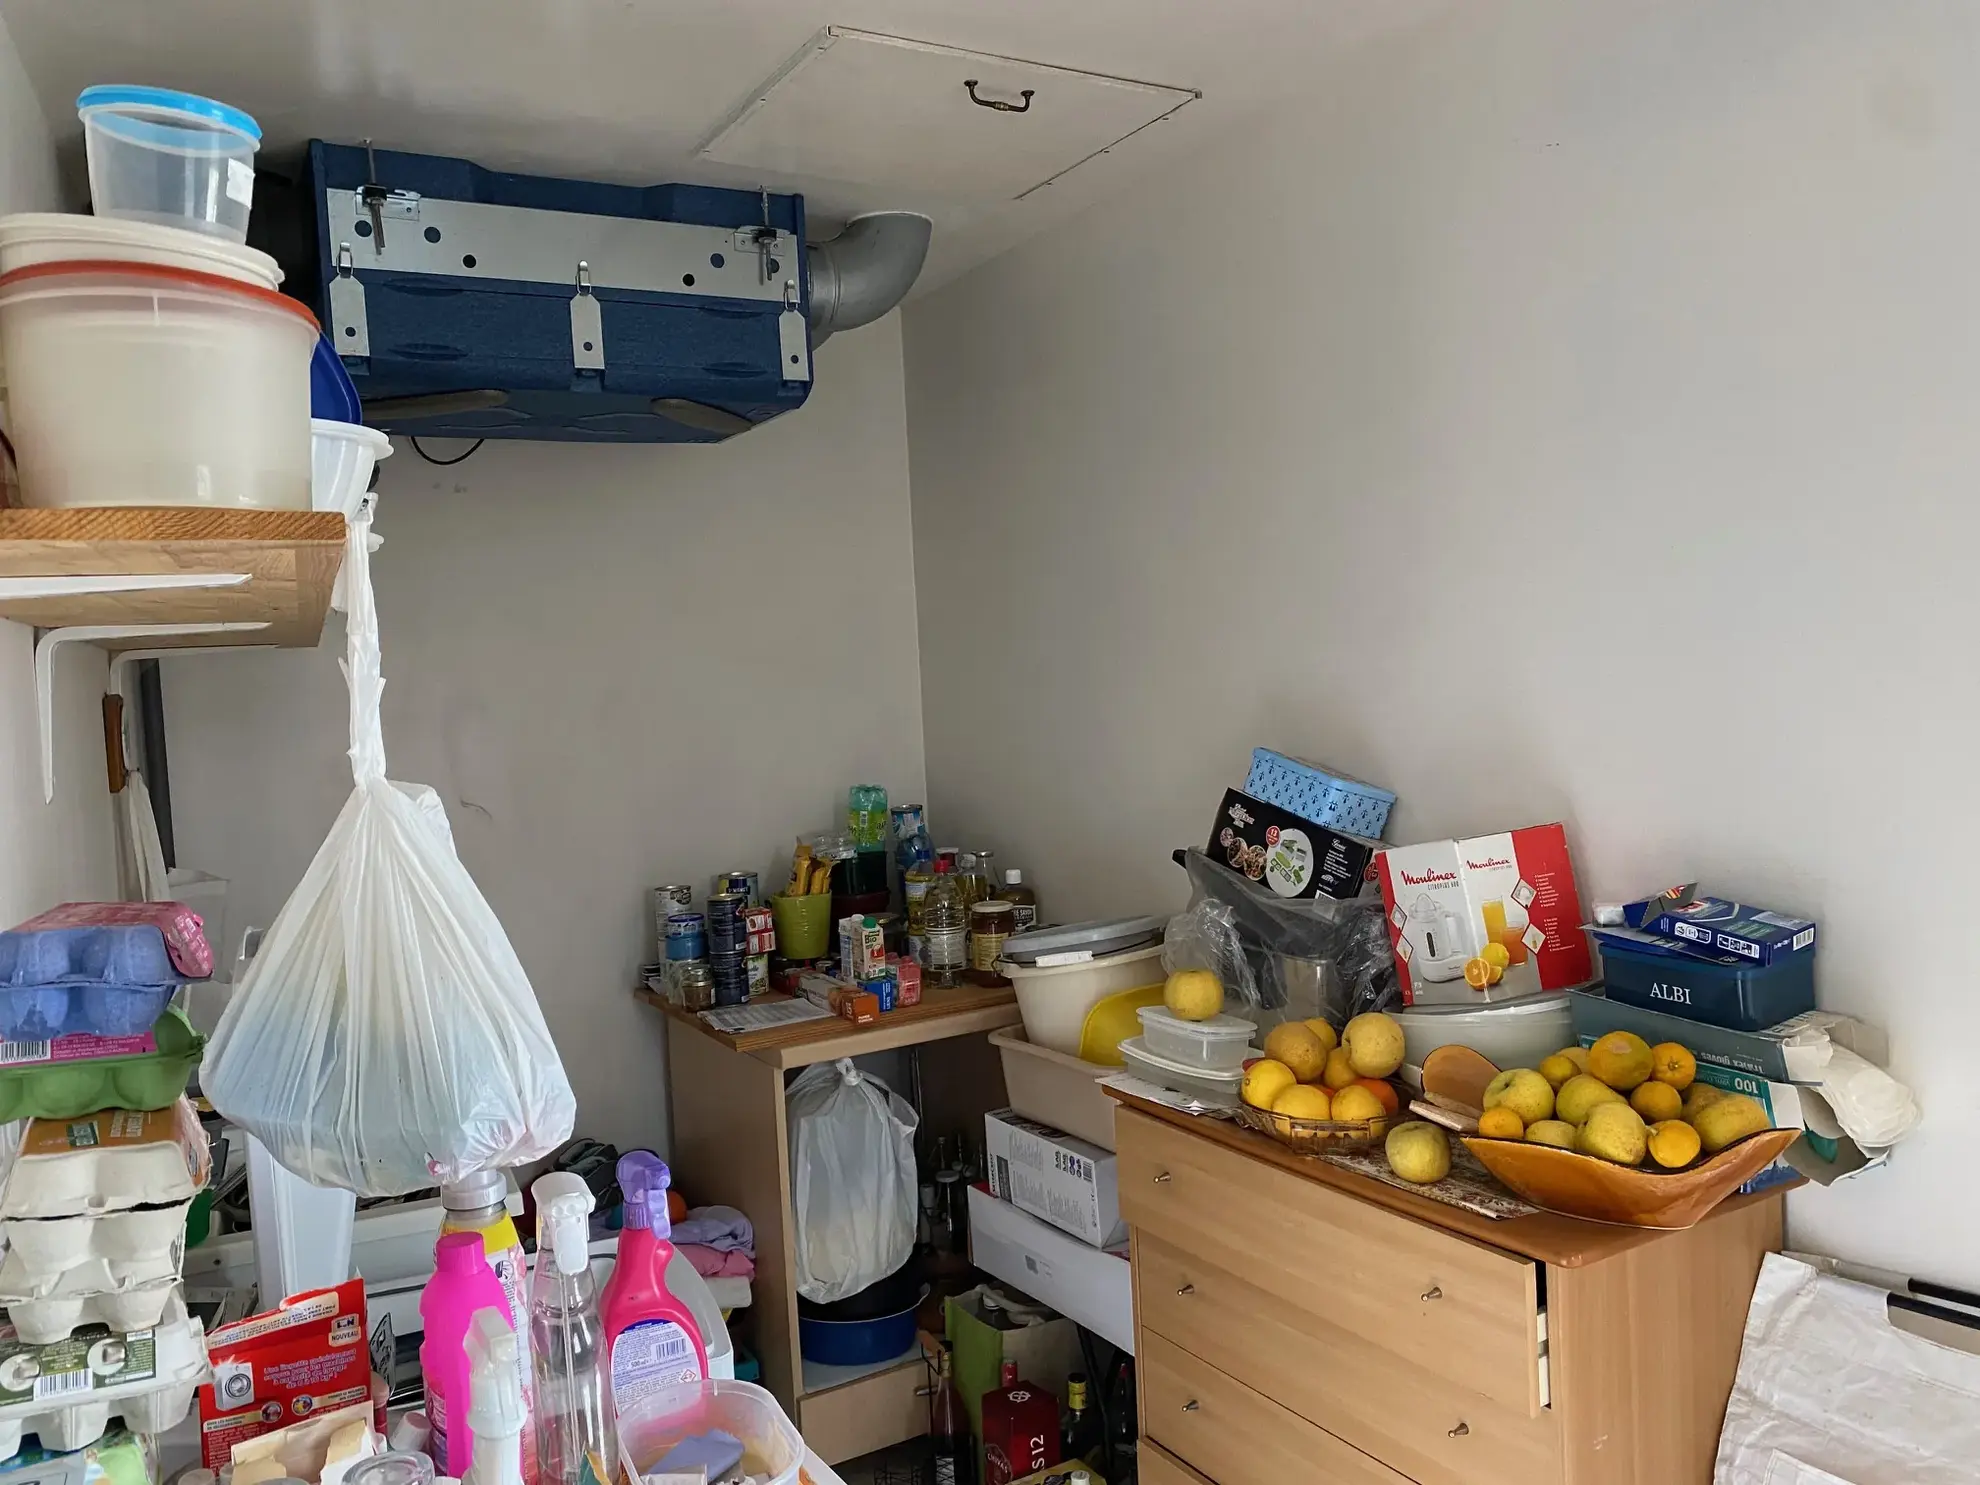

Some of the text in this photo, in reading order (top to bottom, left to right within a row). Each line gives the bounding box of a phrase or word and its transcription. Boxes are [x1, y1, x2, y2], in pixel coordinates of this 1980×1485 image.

[1466, 857, 1511, 870] Moulinex
[1400, 867, 1457, 886] Moulinex
[1649, 982, 1693, 1005] ALBI
[1734, 1077, 1759, 1094] 100
[331, 1330, 359, 1341] NOUVEAU
[1030, 1434, 1044, 1456] 12
[987, 1453, 1008, 1474] CHIVAS
